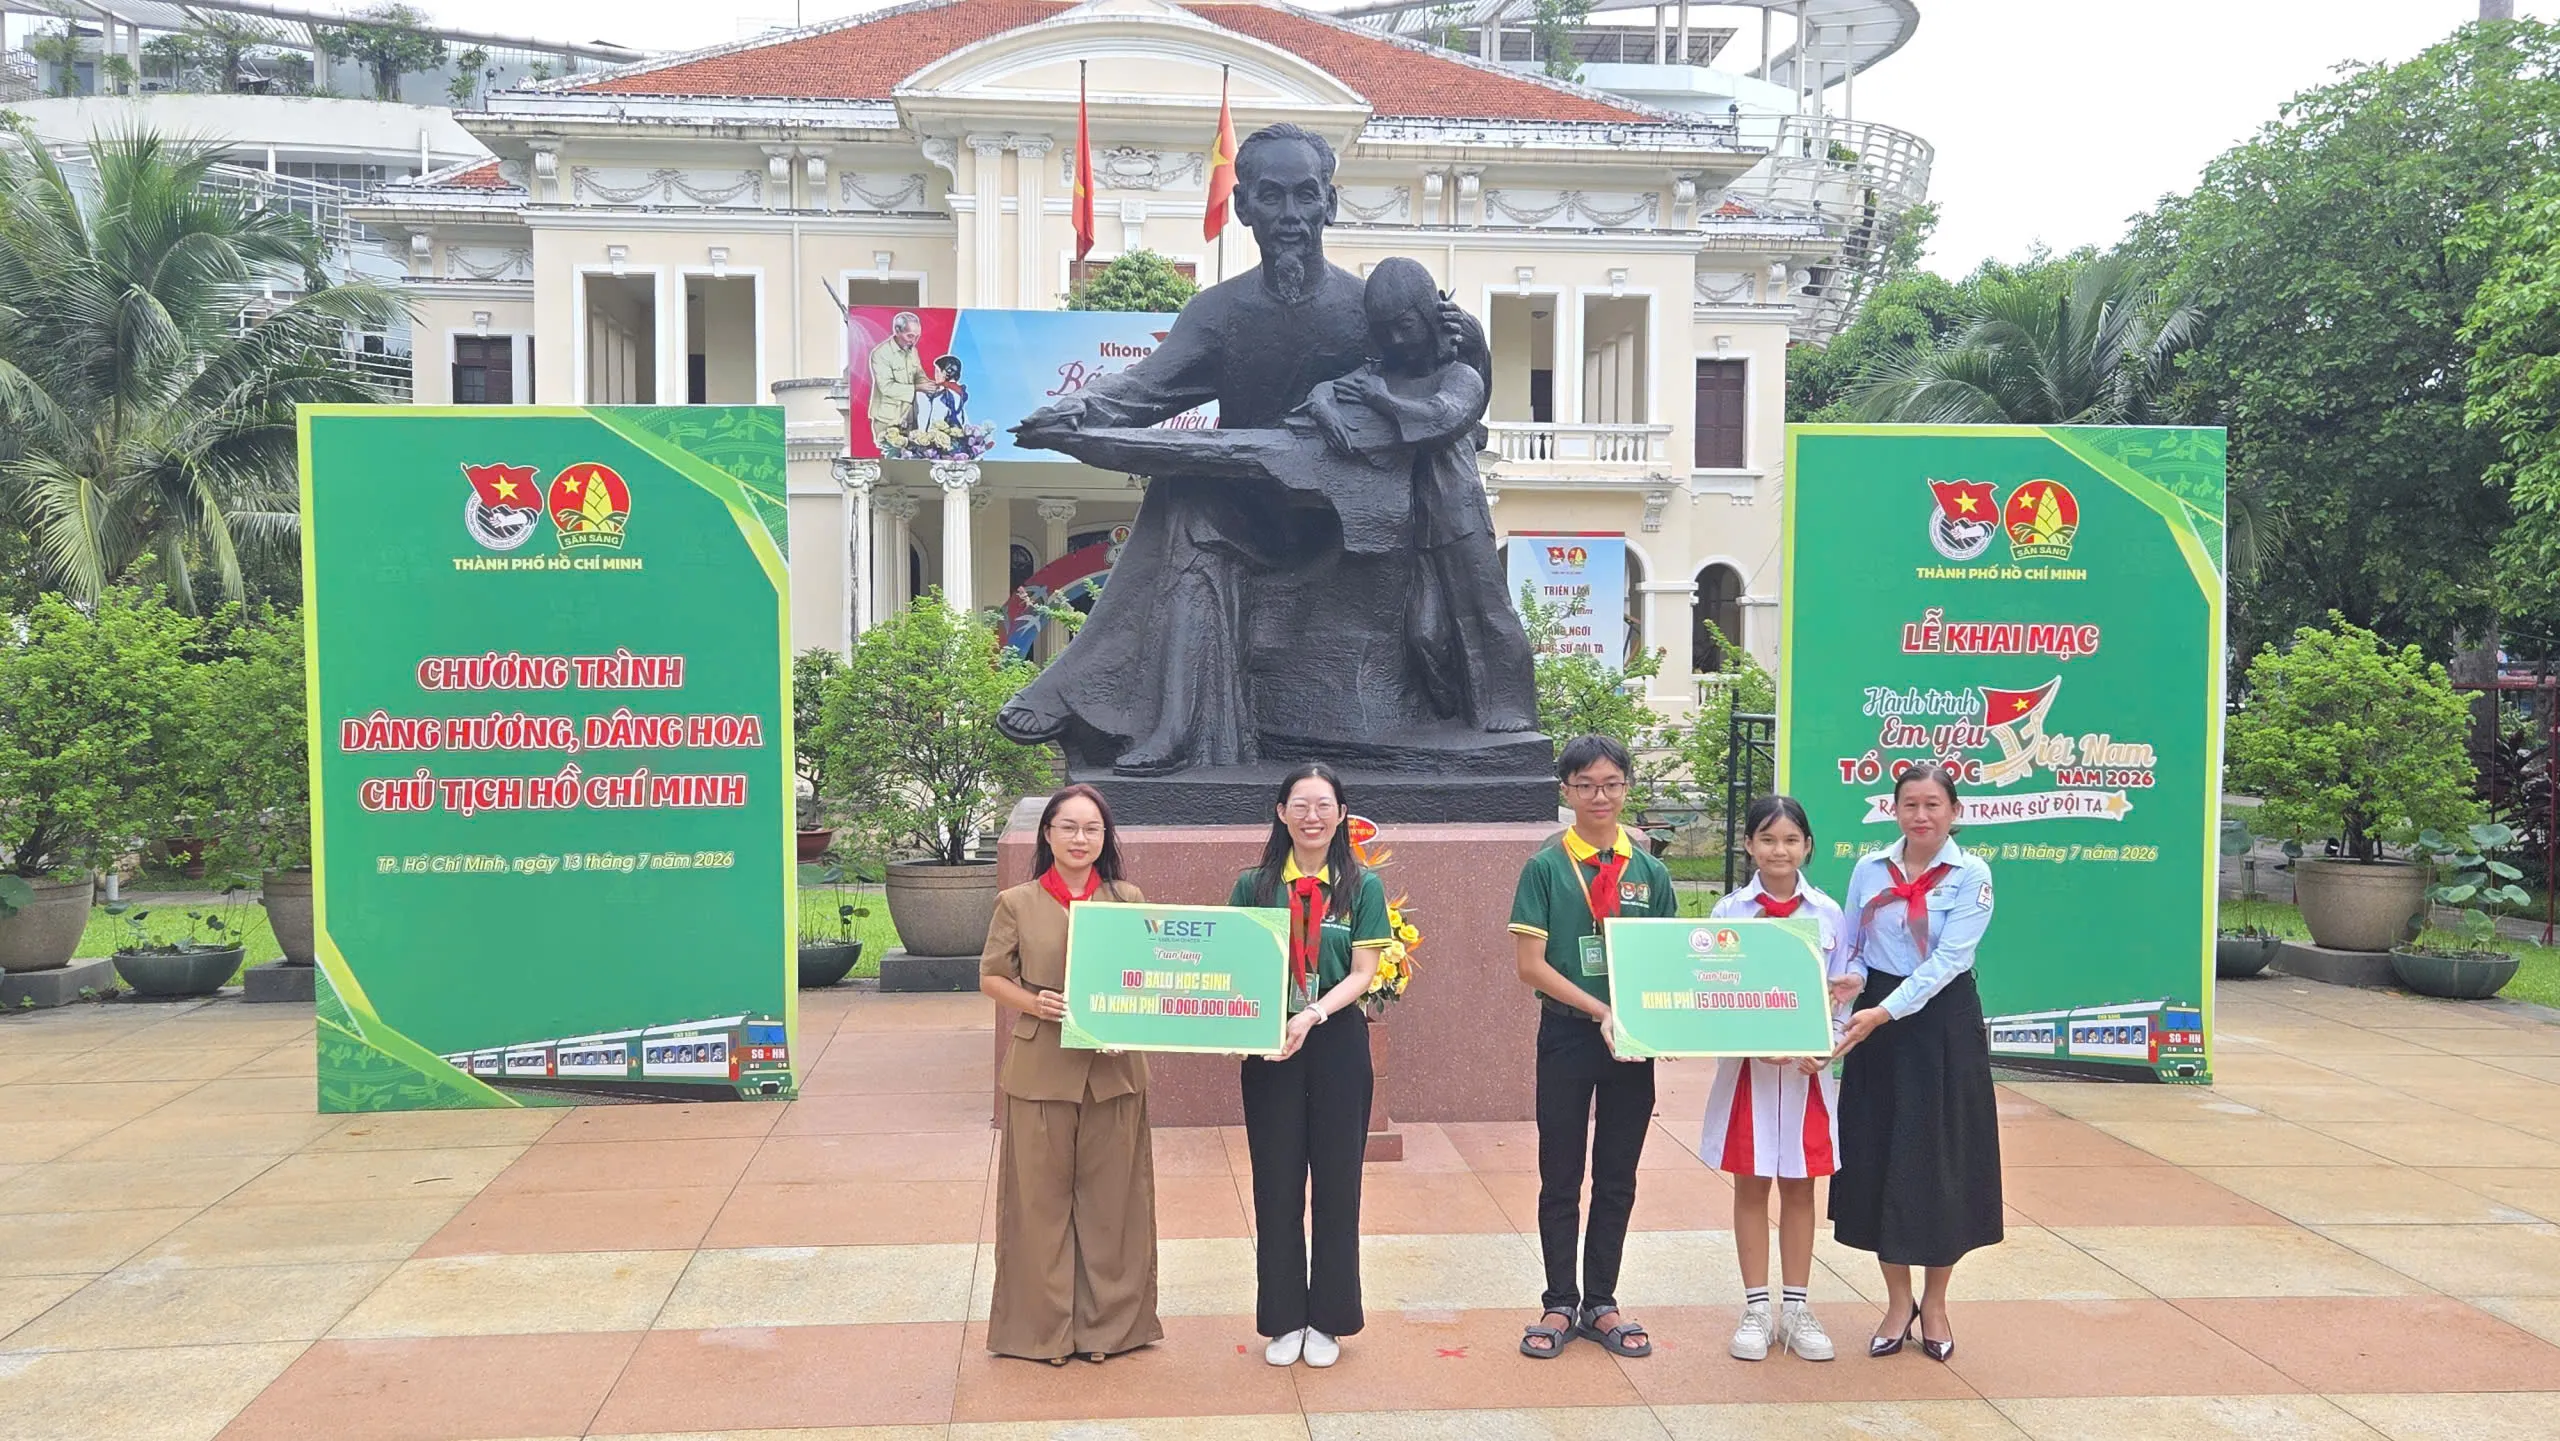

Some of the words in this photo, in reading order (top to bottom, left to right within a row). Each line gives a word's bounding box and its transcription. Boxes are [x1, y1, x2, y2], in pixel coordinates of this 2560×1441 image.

[453, 554, 508, 570] THÀNH
[511, 553, 546, 570] PHỐ
[548, 553, 571, 570] HỒ
[573, 554, 601, 570] CHÍ
[602, 557, 643, 570] MINH
[1916, 563, 1966, 580] THÀNH
[1967, 562, 1999, 580] PHỐ
[2001, 563, 2022, 580] HỒ
[2024, 565, 2049, 580] CHÍ
[2050, 568, 2087, 580] MINH
[1903, 608, 1943, 653] LỄ
[1944, 624, 2024, 654] KHAI
[2026, 624, 2100, 660] MẠC
[1594, 643, 1604, 654] TA
[417, 650, 569, 690] CHƯƠNG
[572, 648, 685, 689] TRÌNH
[1863, 686, 1924, 717] Hành
[1925, 686, 1980, 715] trình
[341, 709, 441, 752] DÂNG
[445, 711, 580, 754] HƯƠNG,
[584, 707, 683, 749] DÂNG
[687, 715, 764, 748] HOA
[1879, 715, 1930, 748] Em
[1932, 716, 1990, 757] yêu
[2079, 733, 2157, 768] Nam
[1838, 749, 1882, 785] TỔ
[1891, 751, 1983, 785] ỐC
[2056, 767, 2103, 787] NĂM
[2106, 769, 2156, 787] 2026
[360, 767, 436, 812] CHỦ
[439, 777, 523, 817] TỊCH
[527, 763, 582, 809] HỒ
[584, 767, 649, 809] CHÍ
[651, 774, 747, 808] MINH
[1969, 800, 2025, 820] TRANG
[2053, 792, 2080, 815] ĐỘI
[2084, 797, 2103, 813] TA
[1834, 841, 1853, 858] TP.
[1856, 840, 1882, 857] Hồ
[1964, 842, 2000, 861] gày
[2001, 842, 2020, 860] 13
[2021, 841, 2068, 864] tháng
[2067, 843, 2082, 860] 7
[2081, 843, 2119, 861] năm
[2119, 844, 2159, 861] 2026
[376, 855, 400, 874] TP.
[402, 853, 428, 873] Hồ
[431, 853, 462, 873] Chí
[463, 854, 510, 874] Minh,
[512, 853, 559, 875] ngày
[563, 853, 582, 871] 13
[584, 851, 636, 873] tháng
[636, 852, 650, 870] 7
[651, 851, 691, 869] năm
[692, 850, 735, 869] 2026
[1143, 918, 1217, 937] WESET
[1122, 969, 1143, 988] 100
[1175, 972, 1200, 993] HỌC
[1201, 973, 1232, 991] SINH
[1107, 994, 1138, 1014] KINH
[1160, 996, 1225, 1017] 10.000.000
[1641, 990, 1672, 1009] KINH
[1695, 990, 1762, 1010] 15.000.000
[2168, 1032, 2181, 1044] SG
[2188, 1032, 2201, 1044] HN
[751, 1048, 765, 1060] SG
[771, 1048, 785, 1060] HN
